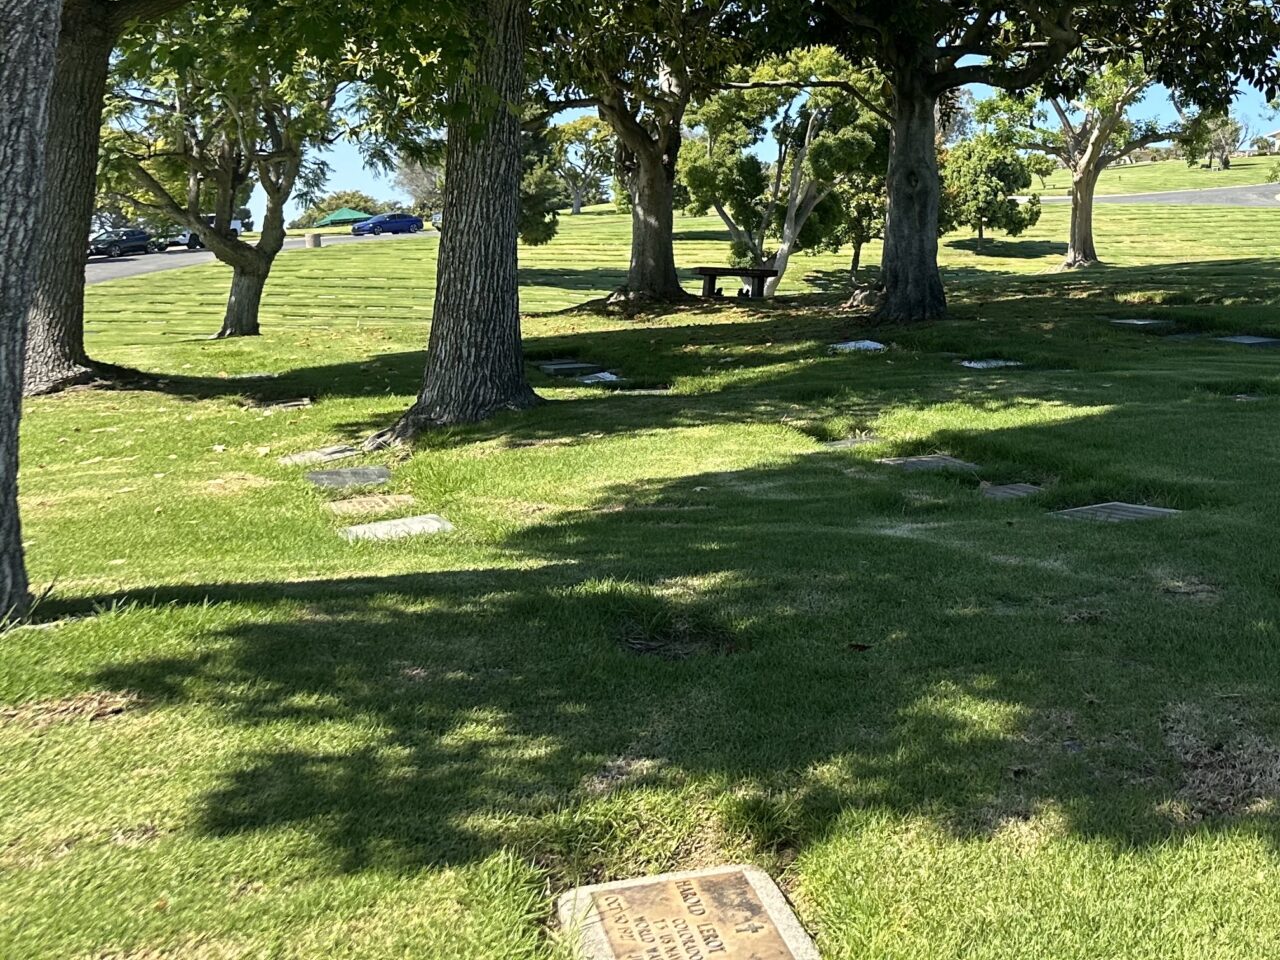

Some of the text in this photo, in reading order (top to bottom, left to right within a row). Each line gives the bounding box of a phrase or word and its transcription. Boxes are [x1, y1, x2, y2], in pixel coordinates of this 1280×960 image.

[605, 895, 623, 912] OCT
[675, 879, 727, 954] HAROLD LEROY
[634, 915, 656, 943] WORLD
